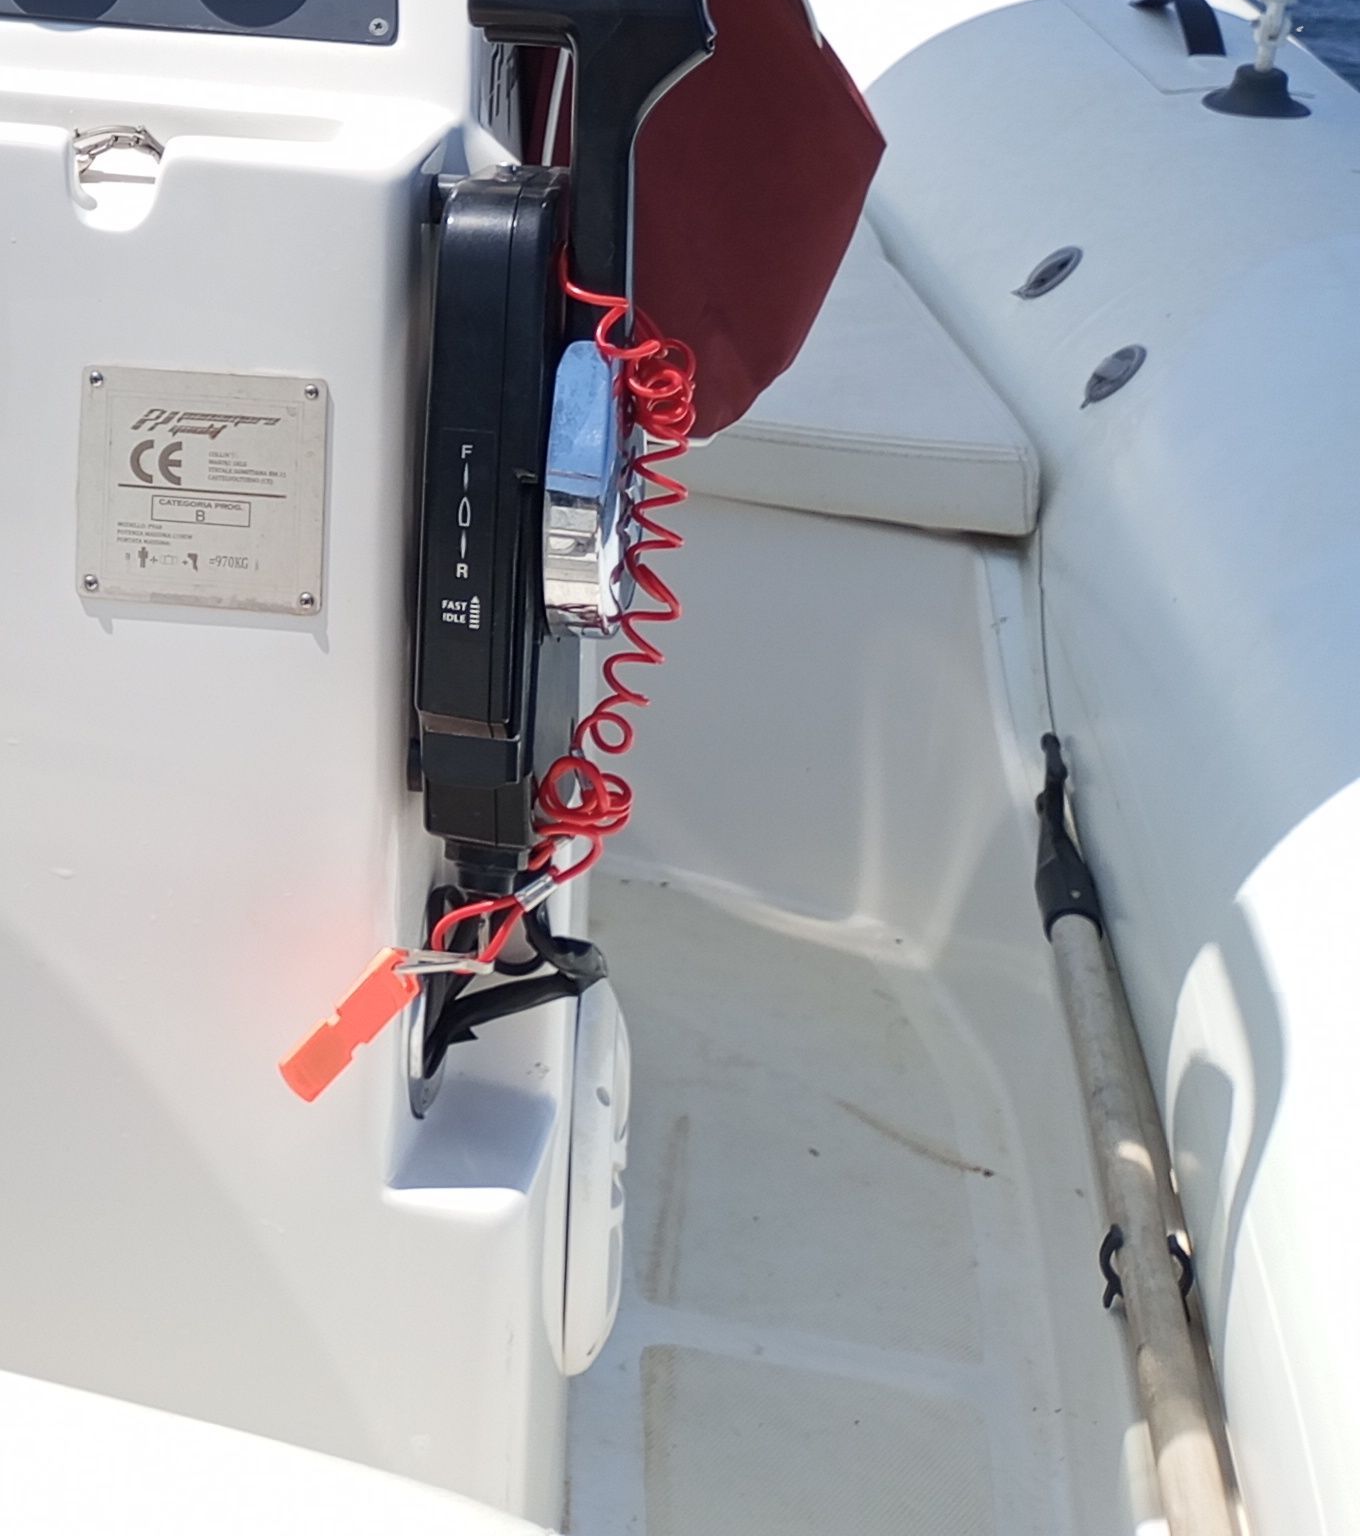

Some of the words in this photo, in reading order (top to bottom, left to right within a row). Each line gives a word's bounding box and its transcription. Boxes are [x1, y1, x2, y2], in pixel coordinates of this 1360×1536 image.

[460, 444, 474, 460] F
[130, 439, 183, 486] CE
[158, 498, 213, 509] CATEGORIA
[195, 509, 206, 522] B
[455, 562, 469, 579] R
[441, 599, 468, 612] FAST
[442, 612, 467, 624] IDLE
